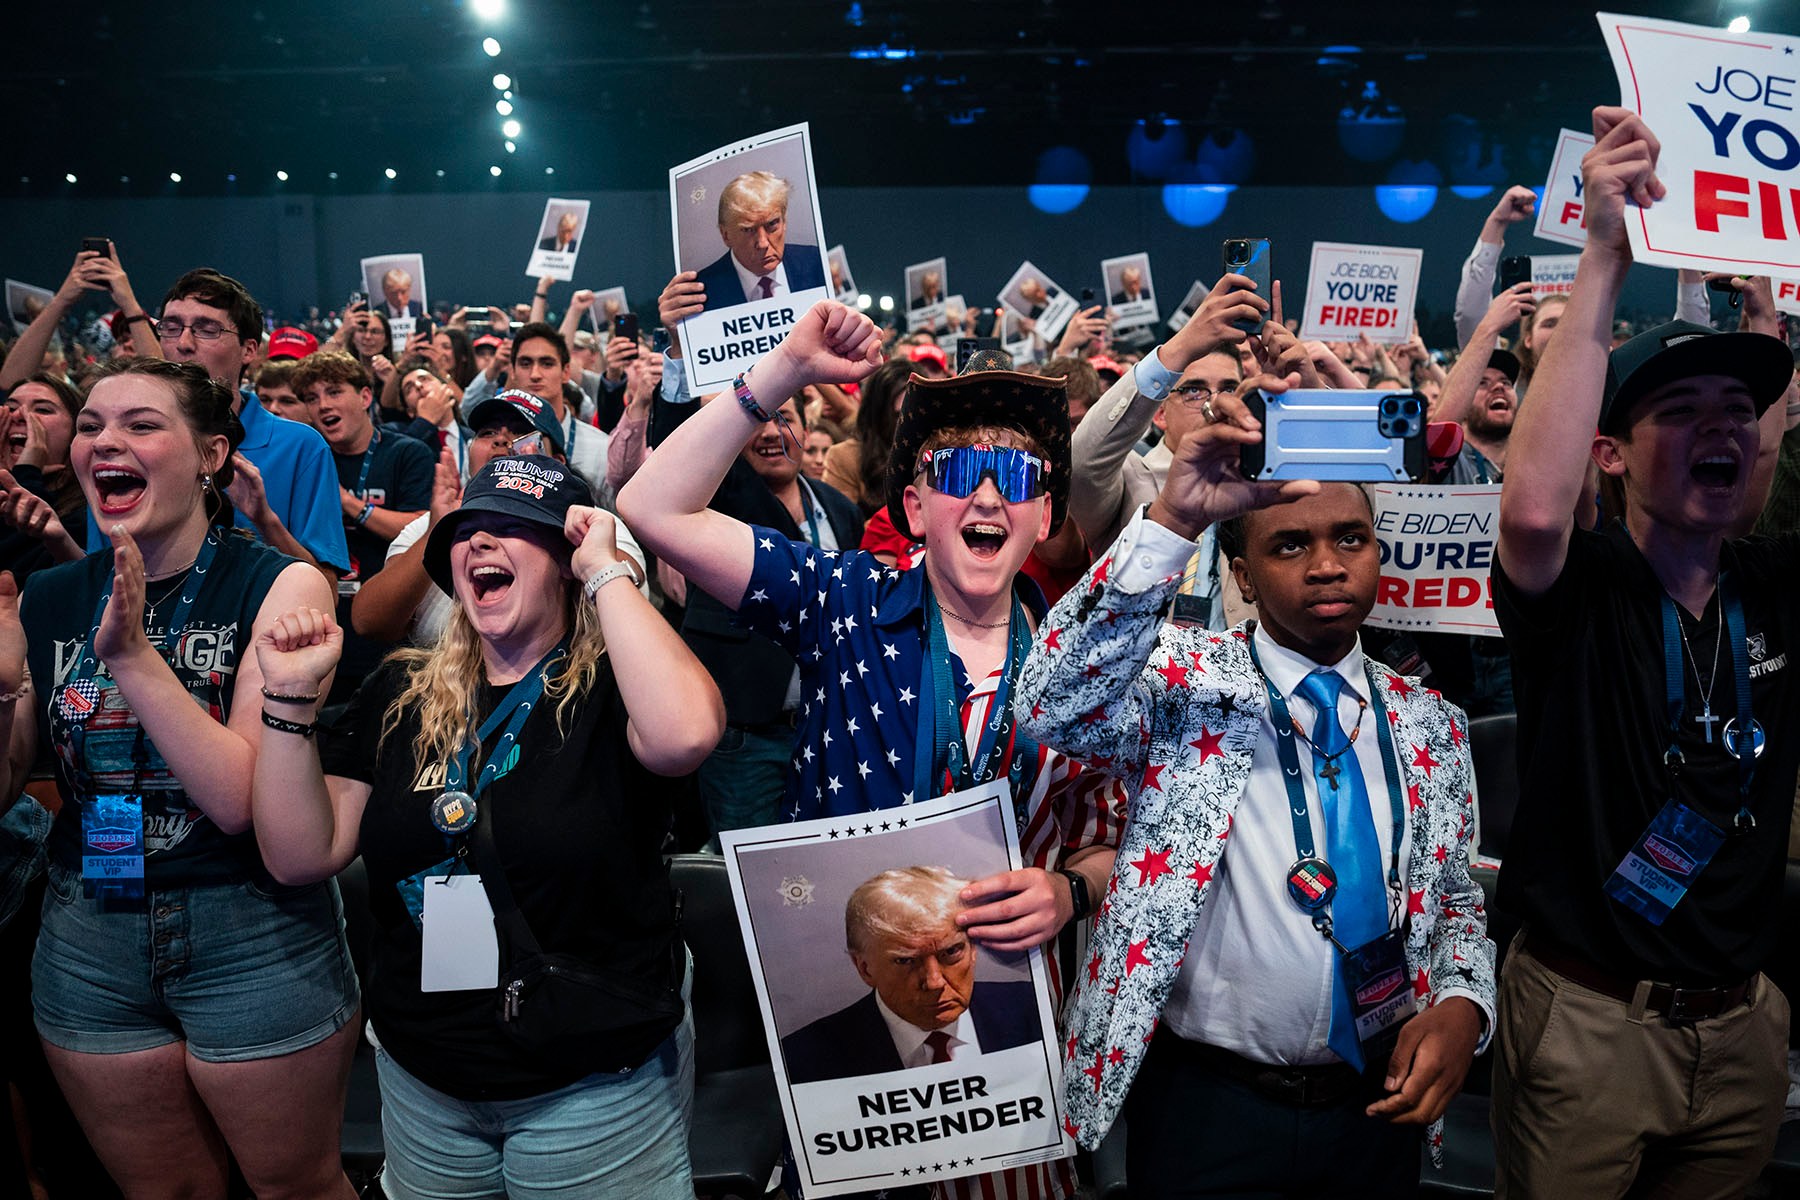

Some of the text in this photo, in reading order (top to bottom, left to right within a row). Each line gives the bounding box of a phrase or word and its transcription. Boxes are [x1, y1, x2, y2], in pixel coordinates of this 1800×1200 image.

[1695, 66, 1797, 111] JOE
[1694, 169, 1800, 241] FI
[1330, 262, 1359, 278] JOE
[1327, 281, 1398, 303] YOU'RE
[722, 307, 796, 338] NEVER
[1319, 305, 1398, 328] FIRED!
[697, 331, 791, 366] SURREN
[494, 459, 565, 484] TRUMP
[509, 471, 536, 481] AMERICA
[536, 477, 555, 489] GREAT
[495, 475, 545, 500] 2024
[1374, 510, 1492, 536] E BIDEN,
[1749, 652, 1788, 679] ST POINT
[87, 858, 136, 867] STUDENT
[104, 867, 121, 876] VIP
[1629, 858, 1679, 894] STUDENT
[1640, 875, 1658, 891] VIP
[1362, 994, 1409, 1026] STUDENT
[1378, 1012, 1396, 1027] VIP
[858, 1075, 989, 1119] NEVER
[813, 1095, 1047, 1156] SURRENDER
